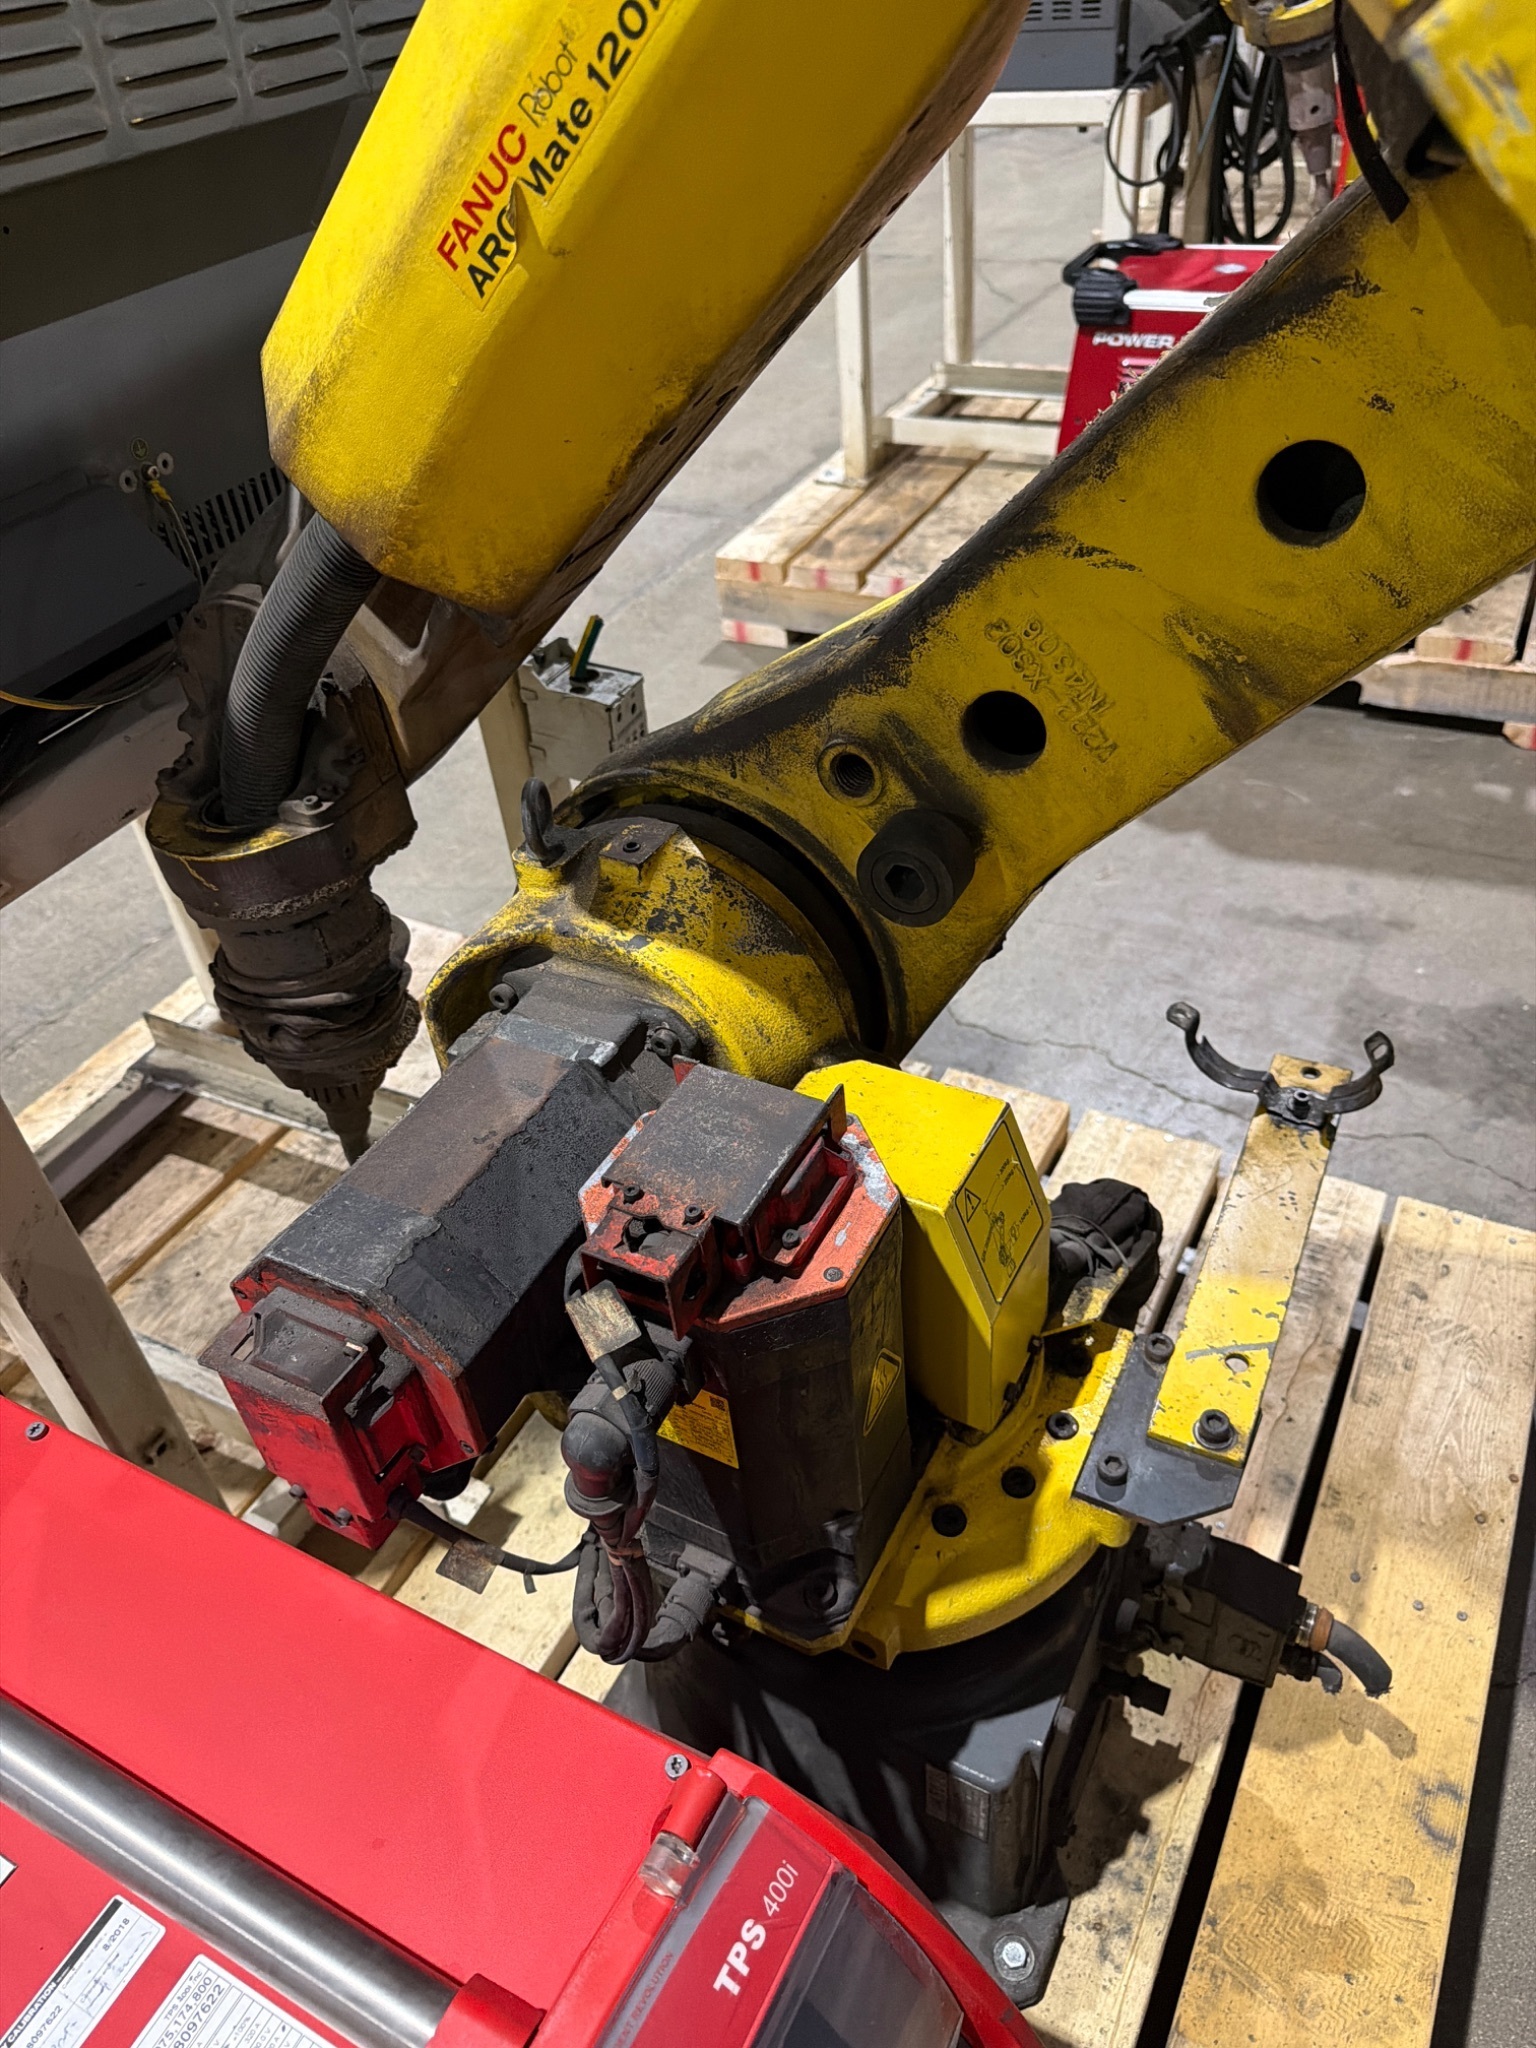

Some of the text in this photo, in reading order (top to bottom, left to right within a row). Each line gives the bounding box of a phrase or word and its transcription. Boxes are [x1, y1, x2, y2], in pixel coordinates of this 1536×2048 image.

[587, 0, 661, 93] 120
[437, 123, 527, 271] FANUC
[1092, 331, 1175, 350] POWER
[102, 1917, 130, 1951] 8/2018
[712, 1860, 799, 1996] TPS 400i
[7, 1981, 57, 2043] CALIBRATION
[164, 2003, 179, 2020] TPS
[631, 1952, 675, 2020] REVOLUTION
